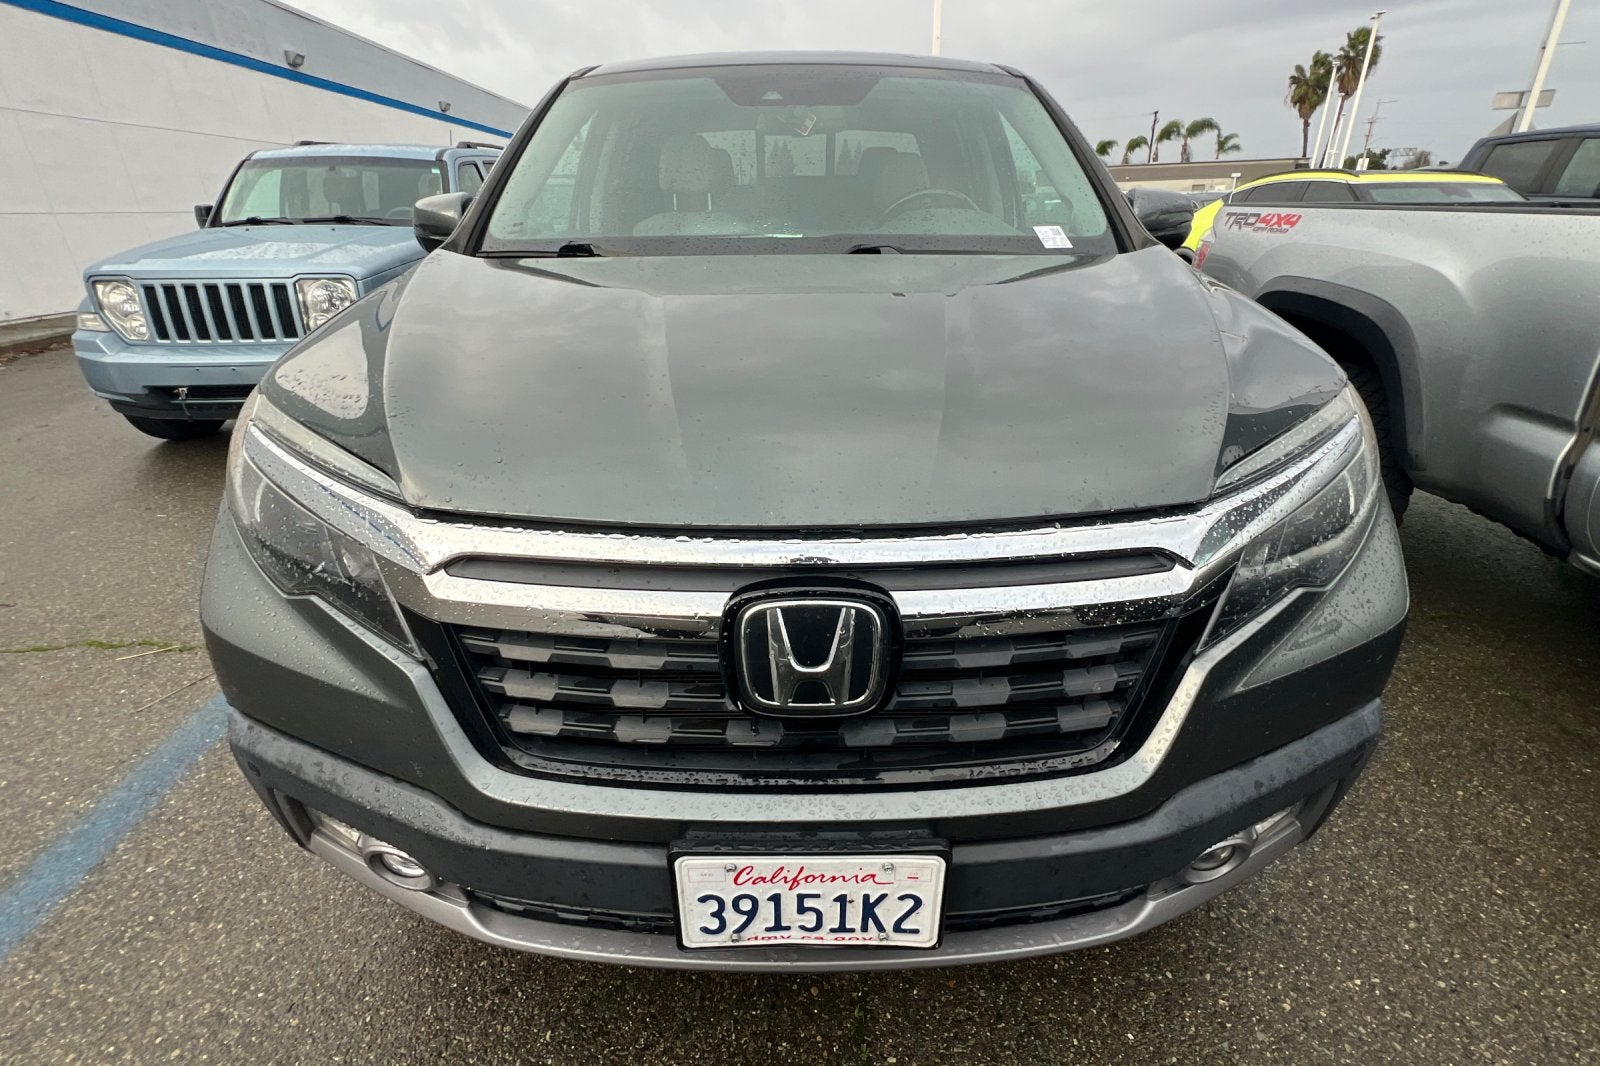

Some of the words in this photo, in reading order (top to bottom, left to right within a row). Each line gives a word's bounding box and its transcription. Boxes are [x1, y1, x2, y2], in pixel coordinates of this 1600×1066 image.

[1225, 212, 1261, 231] TRD
[733, 865, 894, 891] California
[697, 893, 923, 935] 39151K2
